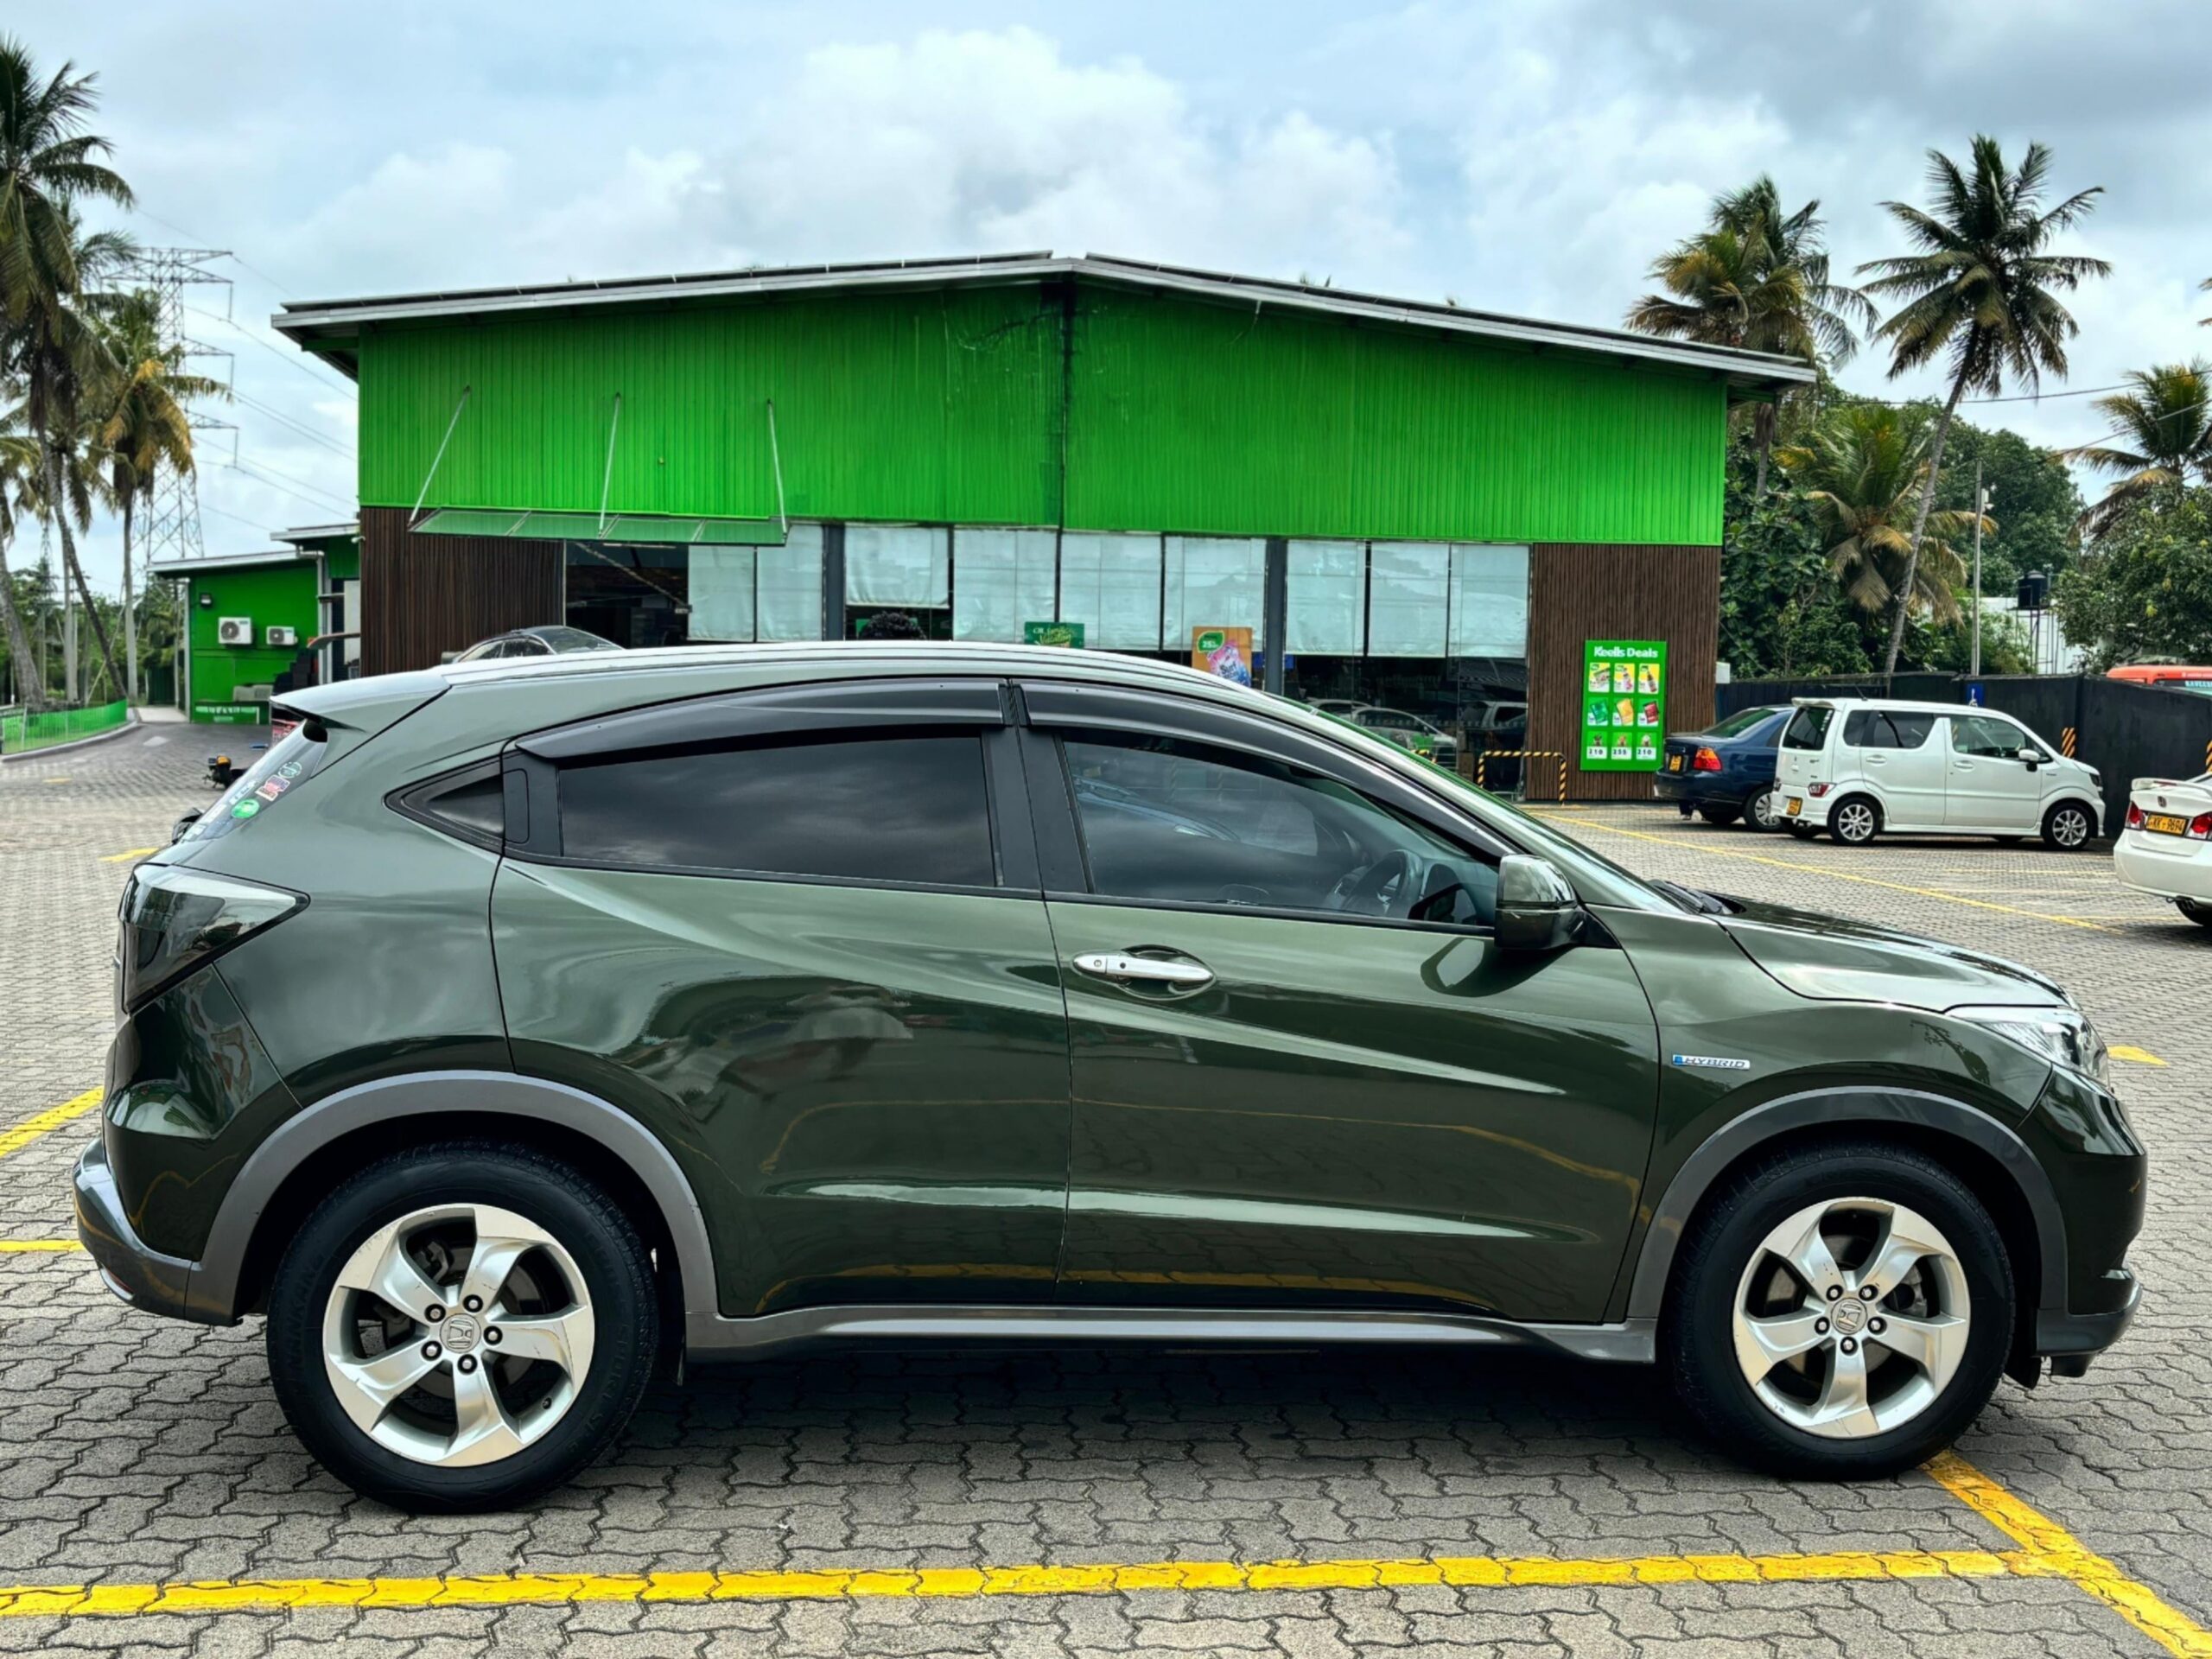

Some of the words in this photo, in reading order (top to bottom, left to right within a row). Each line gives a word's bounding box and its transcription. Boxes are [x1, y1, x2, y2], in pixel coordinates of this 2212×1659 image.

[1594, 646, 1625, 657] Keells
[1627, 648, 1658, 658] Deals
[1685, 1058, 1745, 1068] HYBRID
